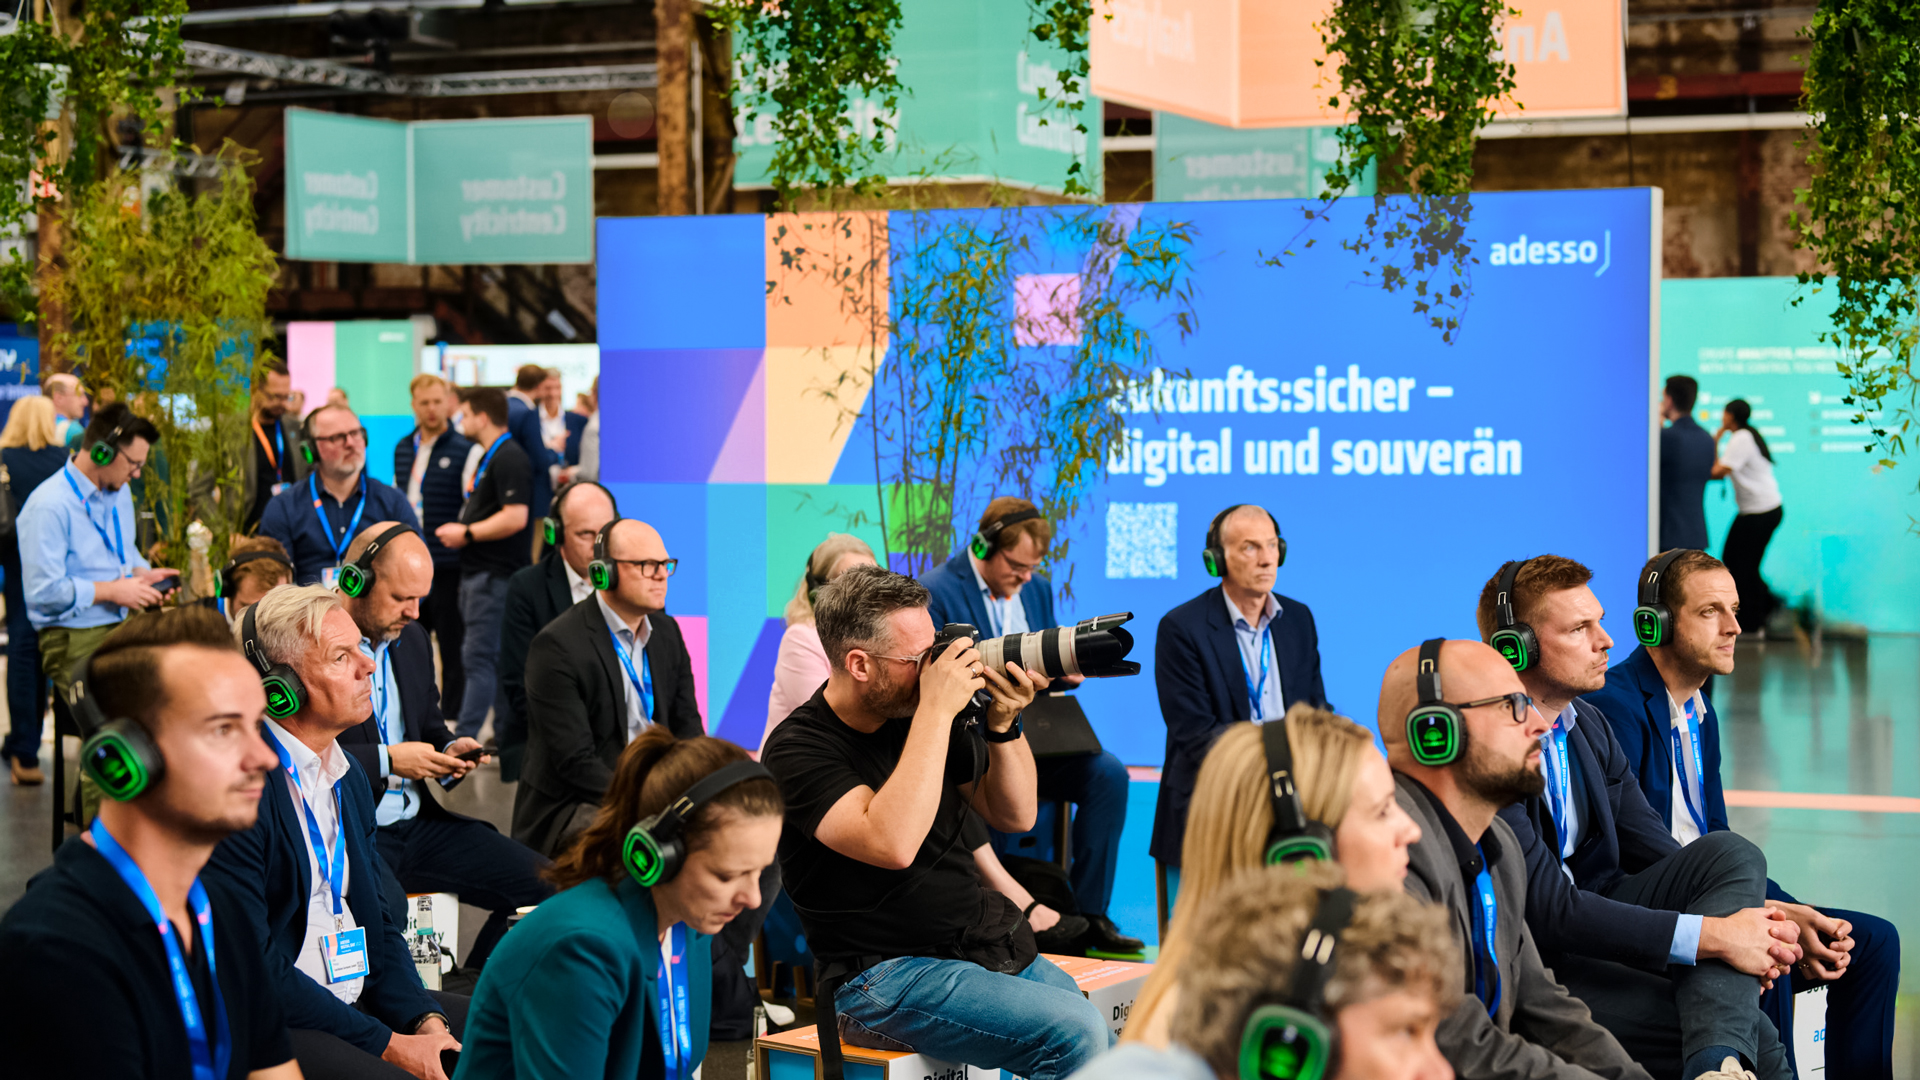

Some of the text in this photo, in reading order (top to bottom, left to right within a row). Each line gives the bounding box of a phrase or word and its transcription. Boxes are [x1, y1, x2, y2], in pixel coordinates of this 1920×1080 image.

[1489, 234, 1598, 266] adesso
[1107, 427, 1523, 487] digital und souverän
[923, 1064, 969, 1080] iital
